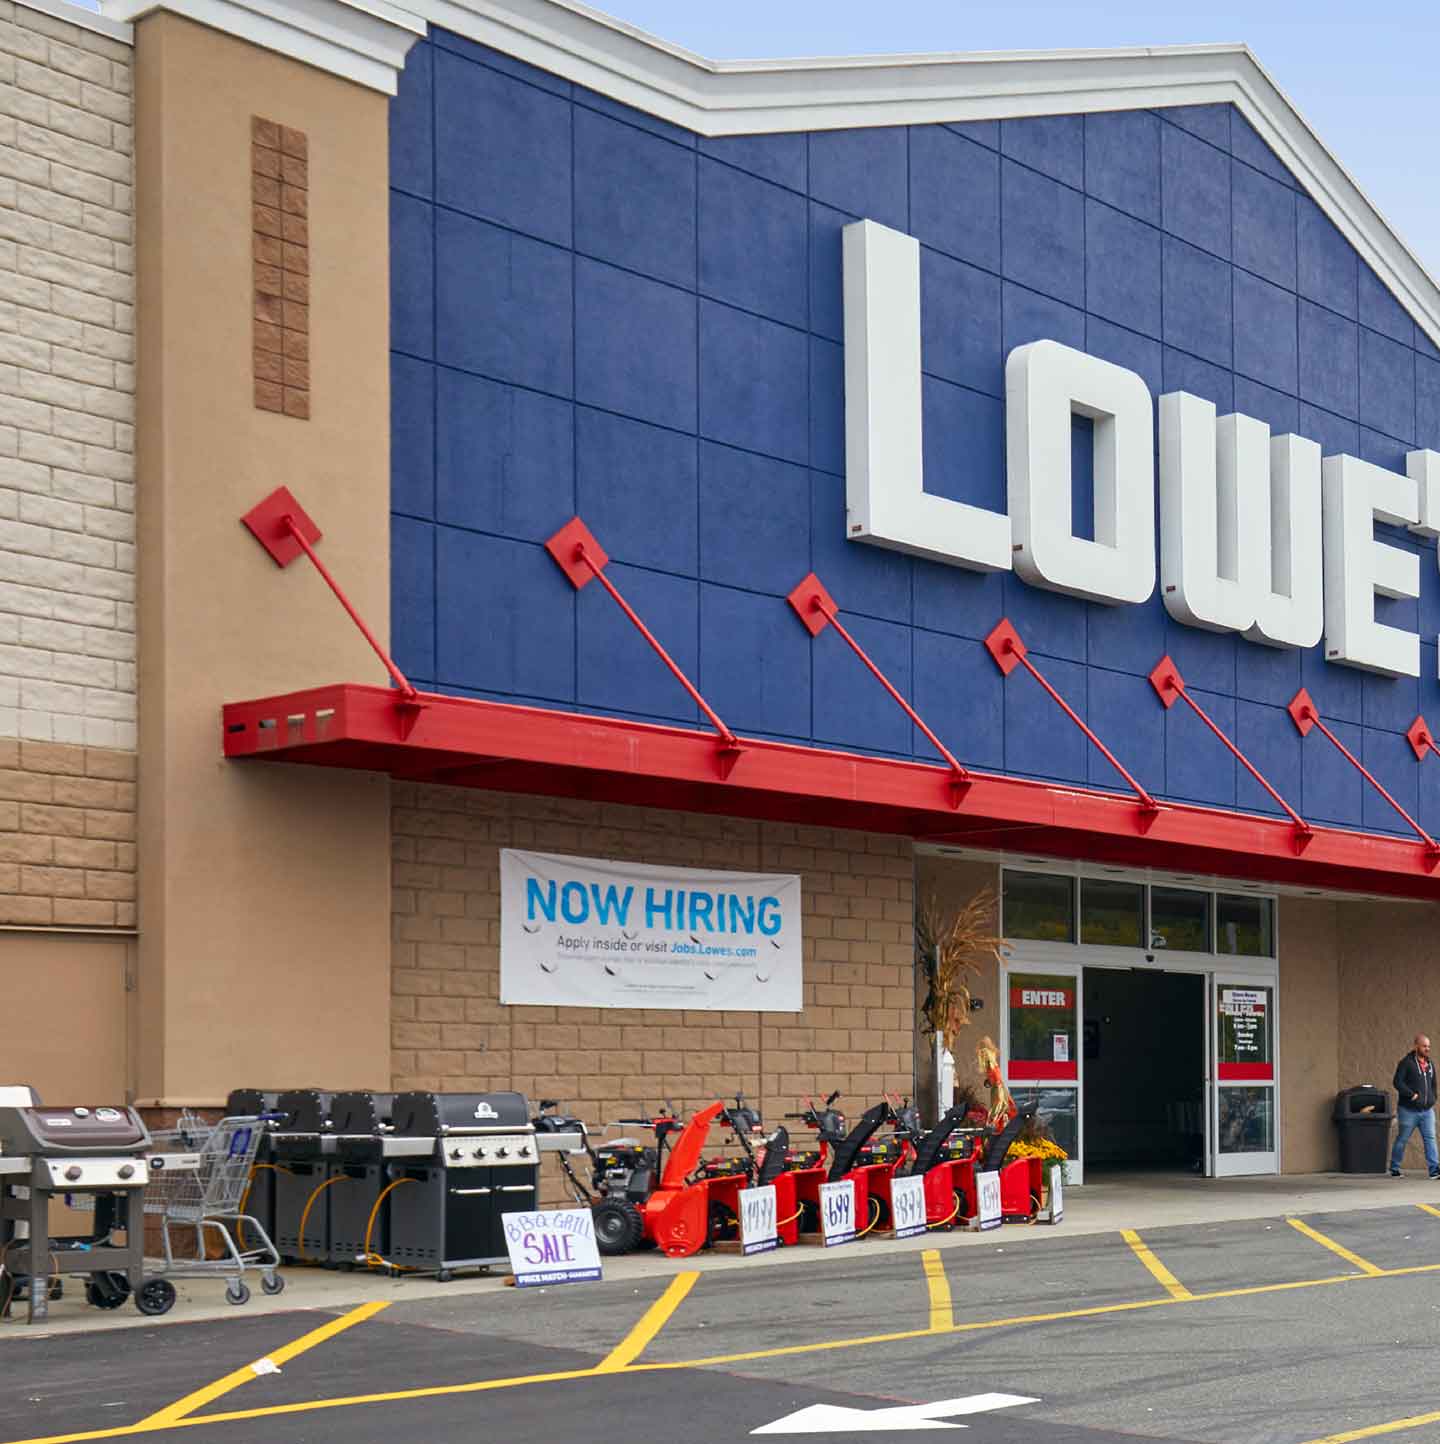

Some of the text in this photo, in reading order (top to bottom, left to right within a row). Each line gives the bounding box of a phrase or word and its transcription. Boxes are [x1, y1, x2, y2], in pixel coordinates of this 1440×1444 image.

[526, 878, 782, 936] NOW HIRING
[557, 935, 590, 952] Apply
[592, 938, 628, 952] inside
[630, 941, 642, 952] or
[644, 940, 668, 953] visit
[1022, 990, 1065, 1006] ENTER
[523, 1233, 576, 1264] SALE
